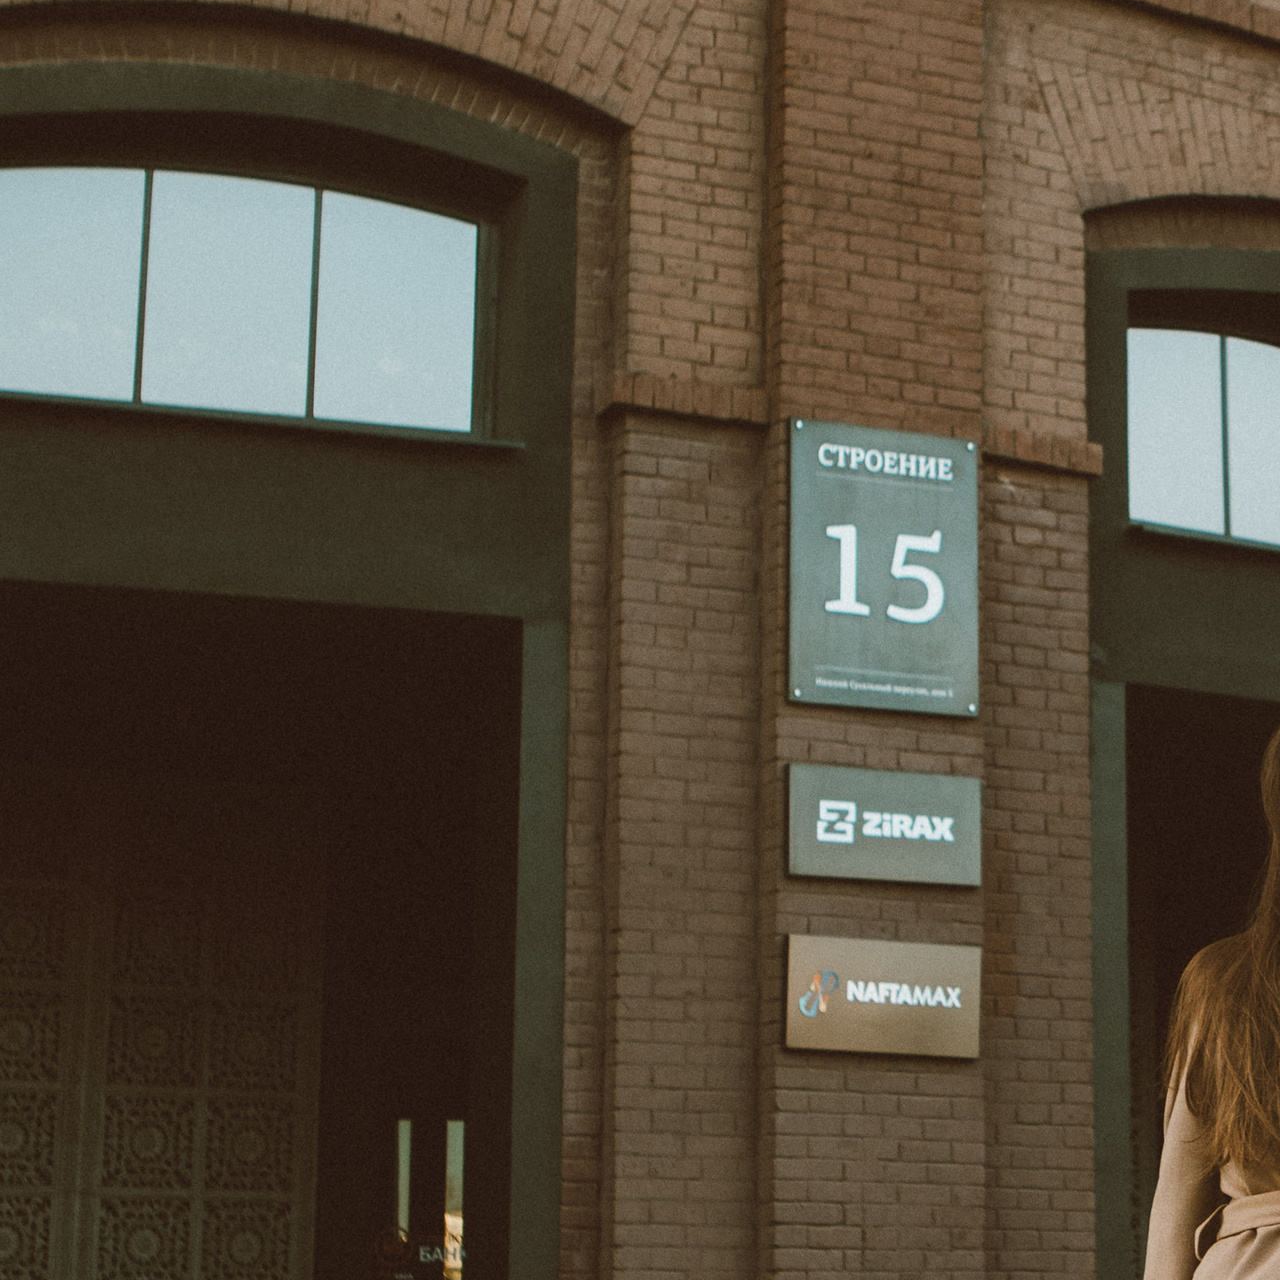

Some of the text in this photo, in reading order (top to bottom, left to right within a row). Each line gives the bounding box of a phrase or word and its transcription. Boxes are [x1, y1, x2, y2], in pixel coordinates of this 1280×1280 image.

[818, 443, 953, 481] СТРОЕНИЕ
[825, 524, 945, 624] 15
[847, 979, 961, 1009] NAFTAMAX
